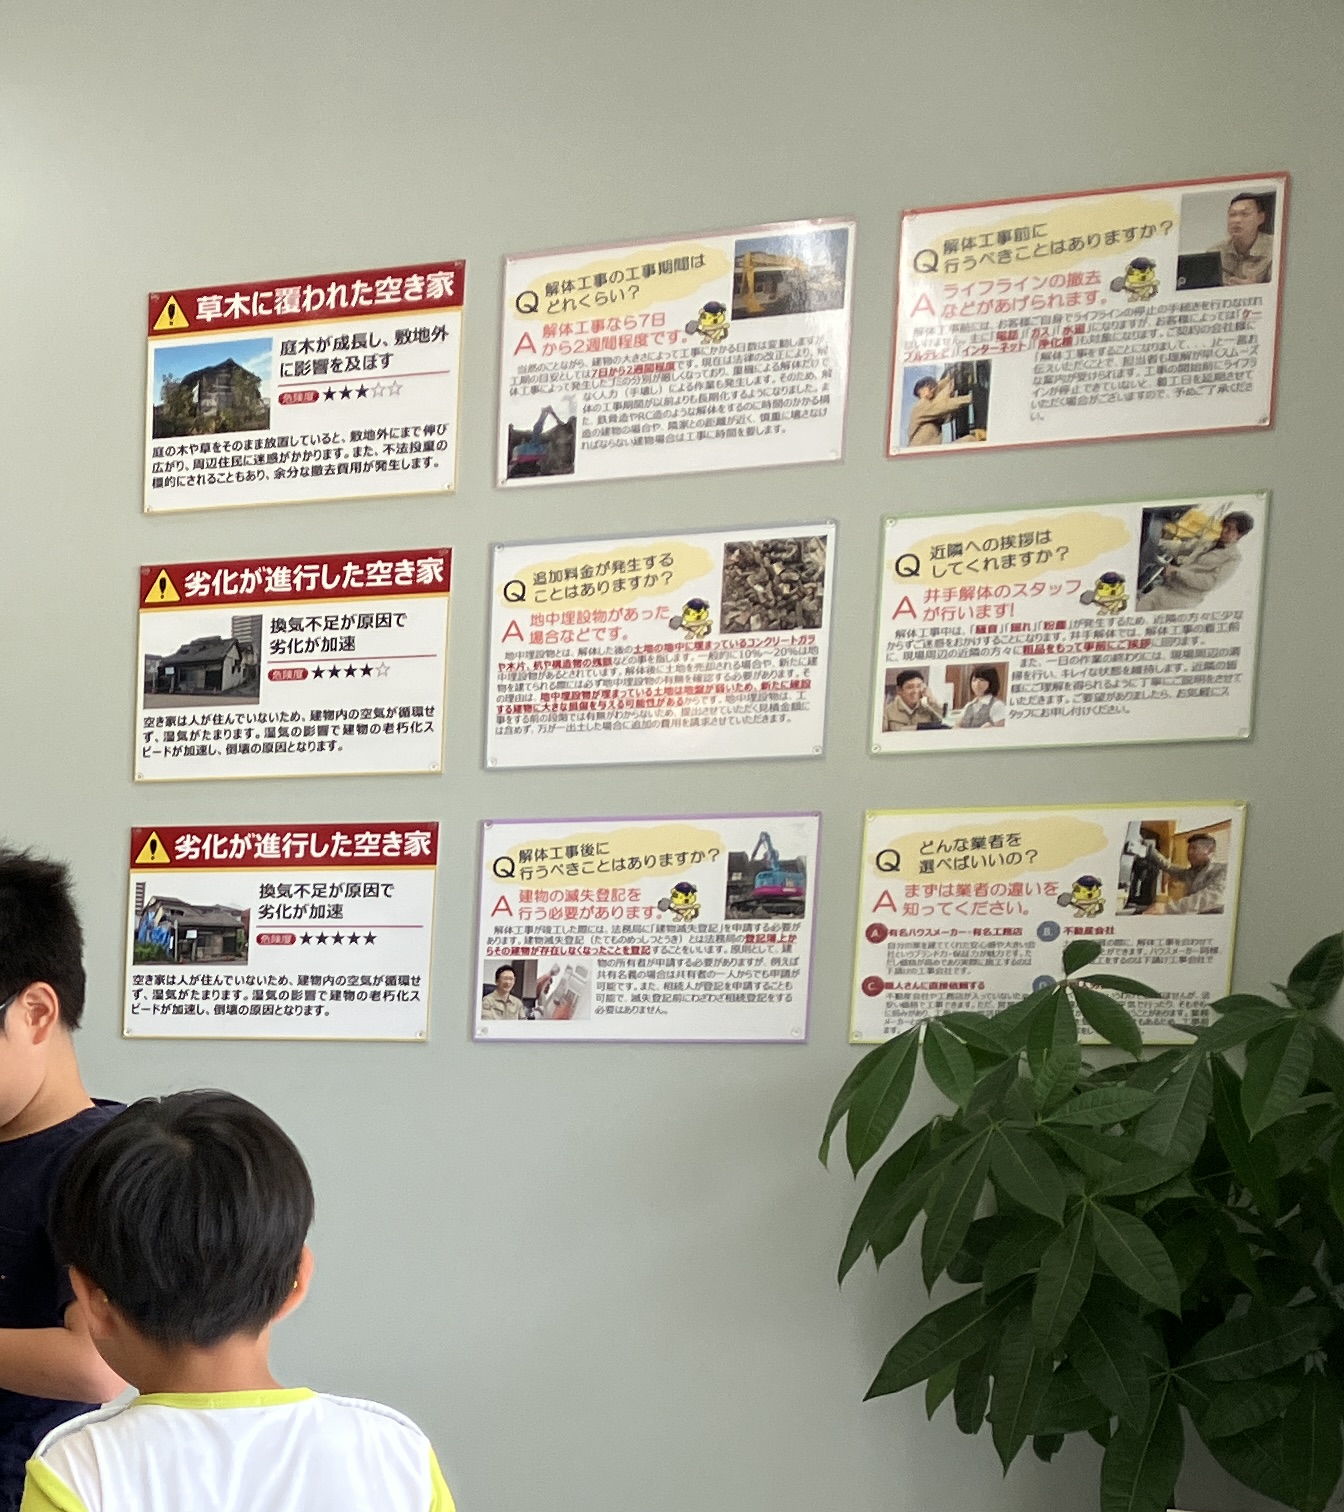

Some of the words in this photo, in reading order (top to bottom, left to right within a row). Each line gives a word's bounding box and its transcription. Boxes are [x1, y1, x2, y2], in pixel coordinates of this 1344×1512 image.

[943, 223, 1048, 254] 解体工事前に
[944, 220, 1174, 273] 行うべきことはありますか？
[913, 248, 939, 273] Q
[545, 253, 707, 298] 解体工事の工事期間は
[943, 270, 1101, 299] ライフラインの撤去
[196, 271, 456, 322] 草木に覆われた空き家
[515, 290, 539, 314] Q
[546, 285, 641, 315] どれくらい？
[910, 293, 936, 318] A
[941, 289, 1108, 318] などがあげられます。
[542, 312, 666, 340] 解体工事なら7日
[279, 324, 450, 357] 庭木が成長し、敷地外
[513, 331, 537, 356] A
[542, 328, 689, 357] から2週間程度です。
[280, 352, 395, 378] に影響を及ぼす
[929, 529, 1053, 561] 近隣への挨拶は
[532, 552, 674, 586] 追加料金が発生する
[895, 553, 920, 577] Q
[932, 545, 1070, 579] してくれますか？
[184, 556, 445, 597] 劣化が進行した空き家
[534, 572, 673, 604] ことはありますか？
[503, 579, 526, 603] Q
[924, 579, 1081, 603] 井手解体のスタッフ
[530, 605, 670, 627] 地中埋設物があった
[892, 595, 918, 619] A
[270, 612, 408, 634] 換気不足が原因で
[501, 620, 524, 643] A
[270, 635, 356, 655] 劣化が加速
[529, 627, 629, 645] 場合などです。
[174, 831, 432, 860] 劣化が進行した空き家
[518, 841, 610, 864] 解体工事後に
[919, 833, 1022, 855] どんな業者を
[493, 856, 516, 879] Q
[519, 849, 719, 881] 行うべきことはありますか？
[876, 849, 900, 872] Q
[919, 851, 1039, 875] 選べばいいの？
[259, 882, 394, 899] 換気不足が原因で
[519, 888, 641, 904] 建物の滅失登記を
[872, 890, 898, 913] A
[904, 881, 1060, 899] まずは業者の違いを
[258, 903, 344, 920] 劣化が加速
[491, 895, 513, 918] A
[519, 905, 663, 922] 行う必要があります。
[902, 901, 1032, 917] 知ってください。
